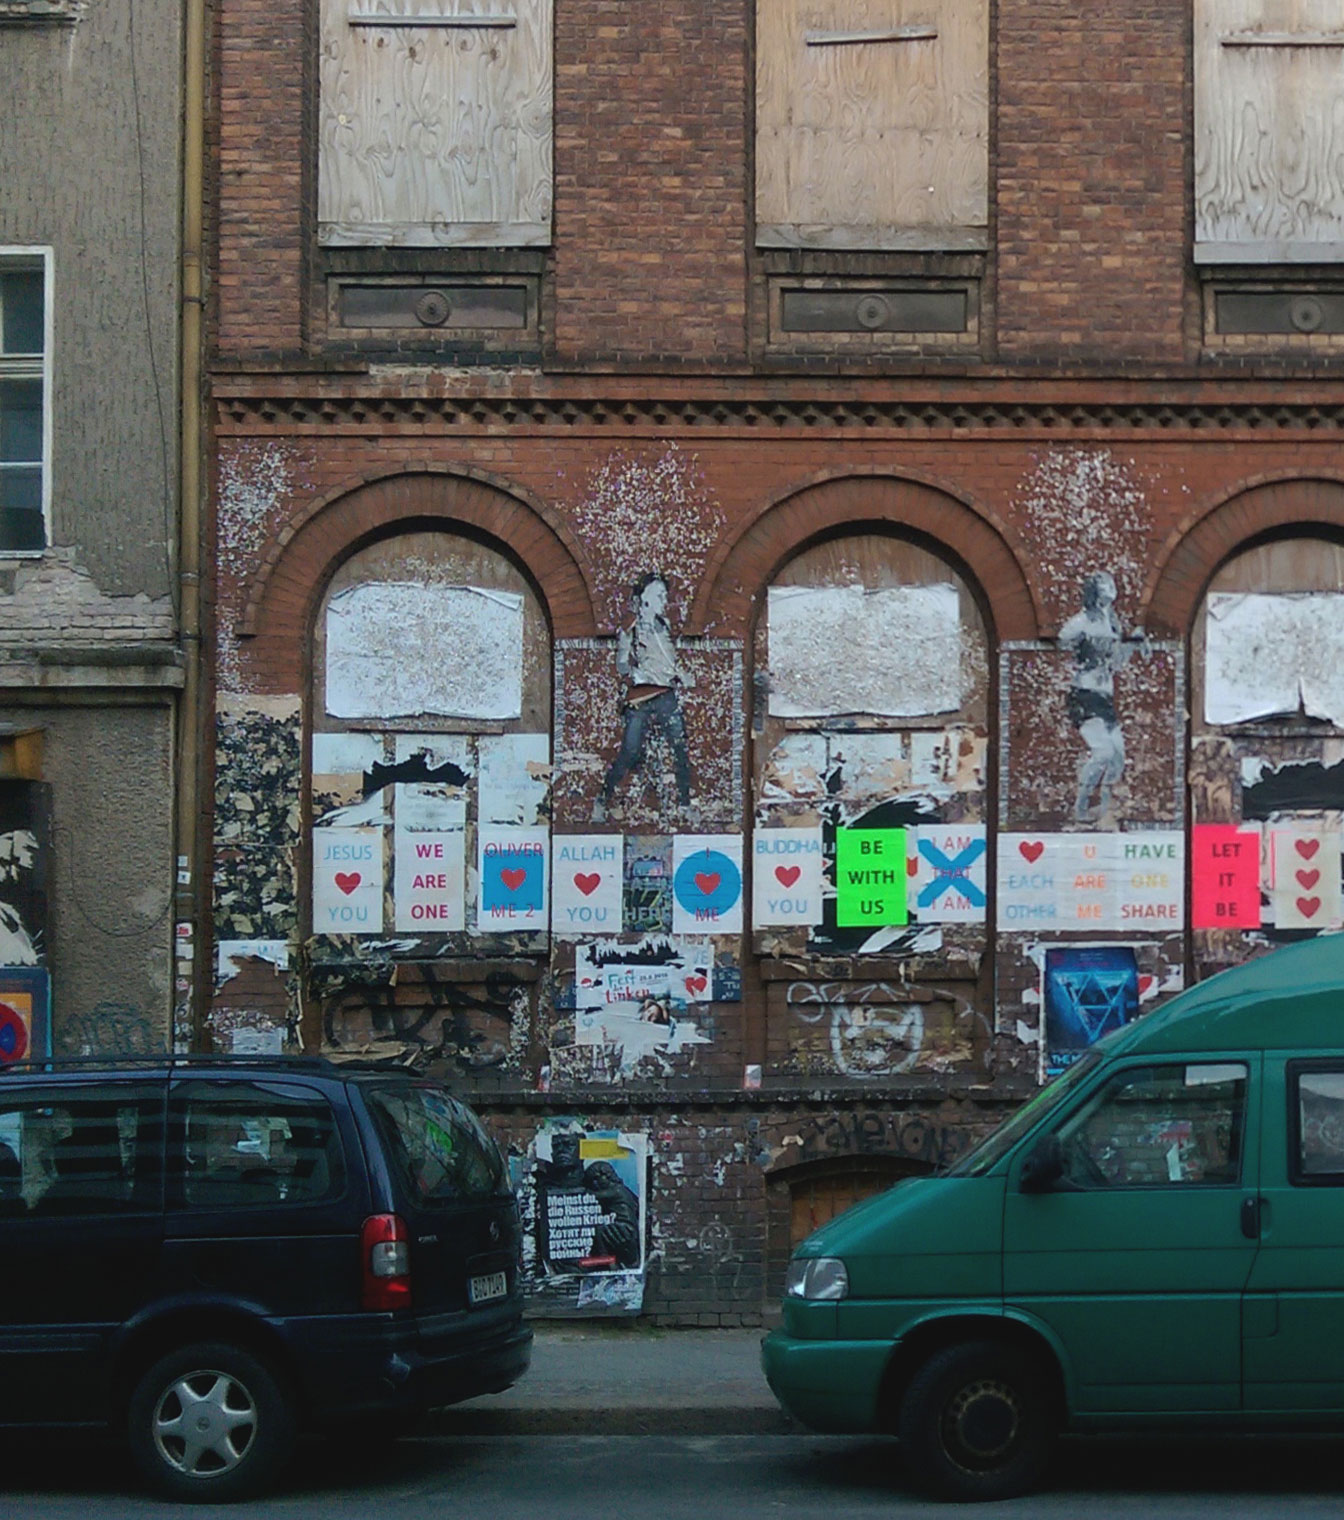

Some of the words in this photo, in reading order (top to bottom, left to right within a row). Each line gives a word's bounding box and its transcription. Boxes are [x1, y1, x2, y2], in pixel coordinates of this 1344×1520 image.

[485, 843, 543, 857] OLIVER
[756, 839, 820, 855] BUDDHA
[861, 841, 883, 855] BE
[943, 836, 971, 850] AM
[1213, 843, 1241, 857] LET
[323, 845, 372, 861] JESUS
[415, 844, 444, 858] WE
[559, 846, 615, 861] ALLAH
[1125, 844, 1176, 859] HAVE
[848, 871, 895, 885] WITH
[932, 866, 970, 880] THAT
[1219, 873, 1234, 887] IT
[412, 874, 447, 889] ARE
[1008, 874, 1054, 889] EACH
[1073, 874, 1106, 889] ARE
[1131, 874, 1169, 888] ONE
[768, 900, 808, 914] YOU
[861, 900, 884, 914] US
[943, 896, 971, 910] AM
[1216, 903, 1238, 917] BE
[328, 906, 368, 921] YOU
[411, 904, 449, 919] ONE
[491, 904, 517, 918] ME
[525, 903, 535, 918] 2
[567, 907, 608, 922] YOU
[695, 908, 719, 922] ME
[1006, 904, 1056, 919] OTHER
[1077, 904, 1102, 918] ME
[1121, 904, 1178, 919] SHARE
[1052, 1055, 1068, 1065] THE
[547, 1194, 582, 1206] Meinst
[548, 1206, 564, 1218] die
[564, 1204, 602, 1216] Russen
[548, 1215, 582, 1228] wollen
[583, 1213, 617, 1226] Krieg?
[549, 1228, 580, 1239] Хотят
[581, 1227, 596, 1237] ли
[549, 1237, 593, 1250] русские
